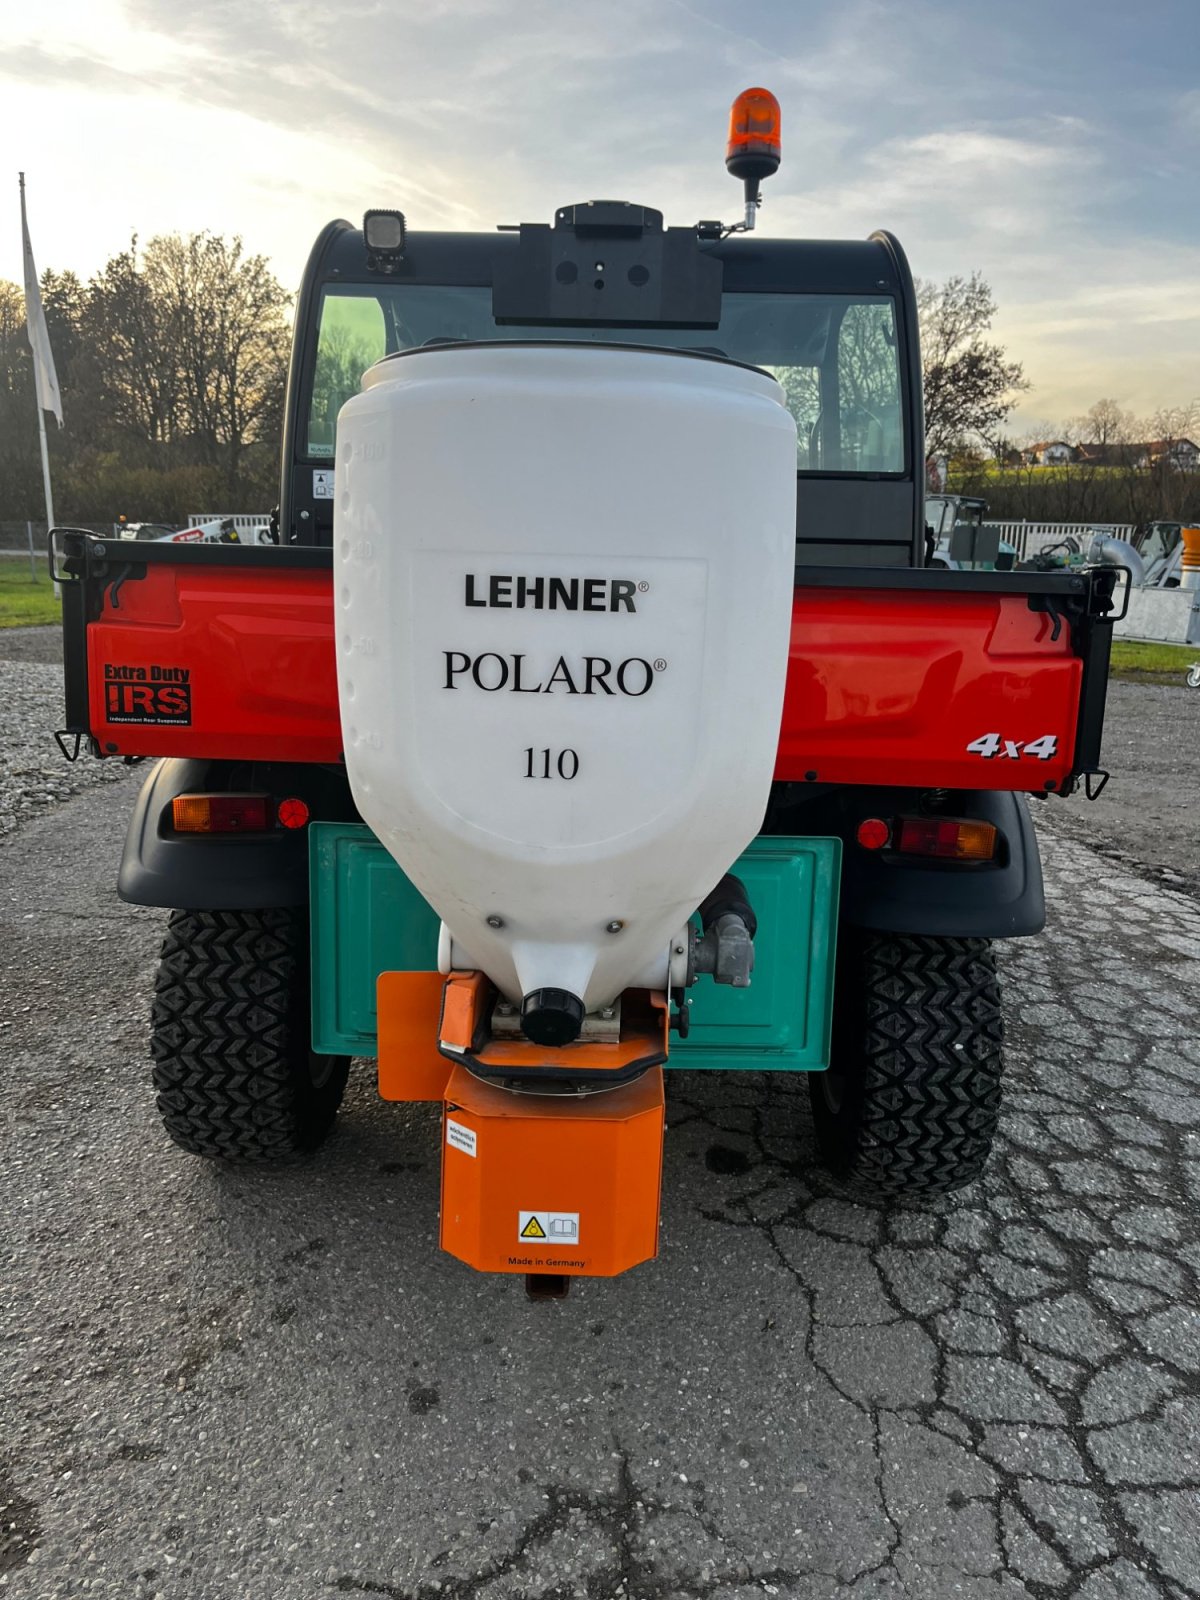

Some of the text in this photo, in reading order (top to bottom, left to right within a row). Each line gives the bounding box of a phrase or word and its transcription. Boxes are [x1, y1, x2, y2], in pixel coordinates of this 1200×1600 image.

[104, 663, 190, 683] Extra Duty
[109, 685, 188, 715] IRS
[966, 733, 1057, 758] 4x4
[523, 747, 579, 780] 110
[508, 1257, 586, 1268] Made in Germany
